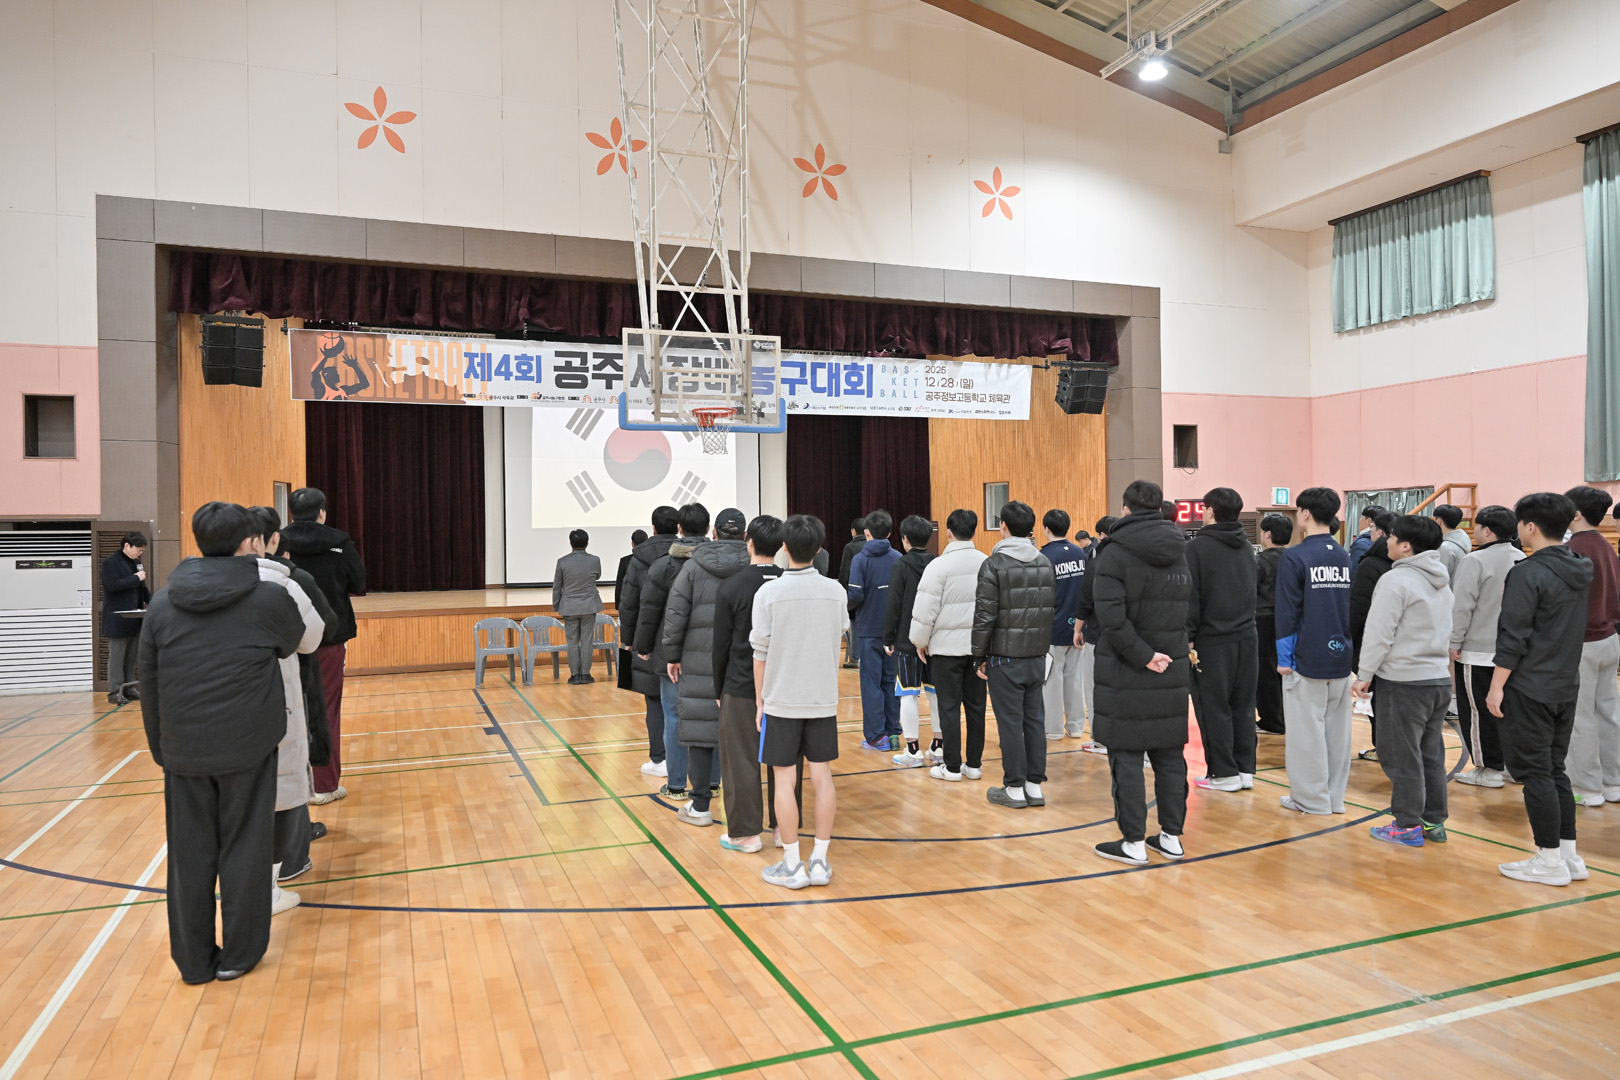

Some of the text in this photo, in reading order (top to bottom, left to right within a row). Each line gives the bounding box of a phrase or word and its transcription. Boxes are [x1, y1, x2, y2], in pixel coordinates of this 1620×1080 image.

[464, 352, 542, 384] 제4회
[925, 365, 947, 374] 2025
[891, 377, 918, 387] KET
[880, 389, 918, 399] BALL
[925, 391, 1011, 404] 공주정보고등학교 체육관
[1055, 560, 1085, 576] KONGJU
